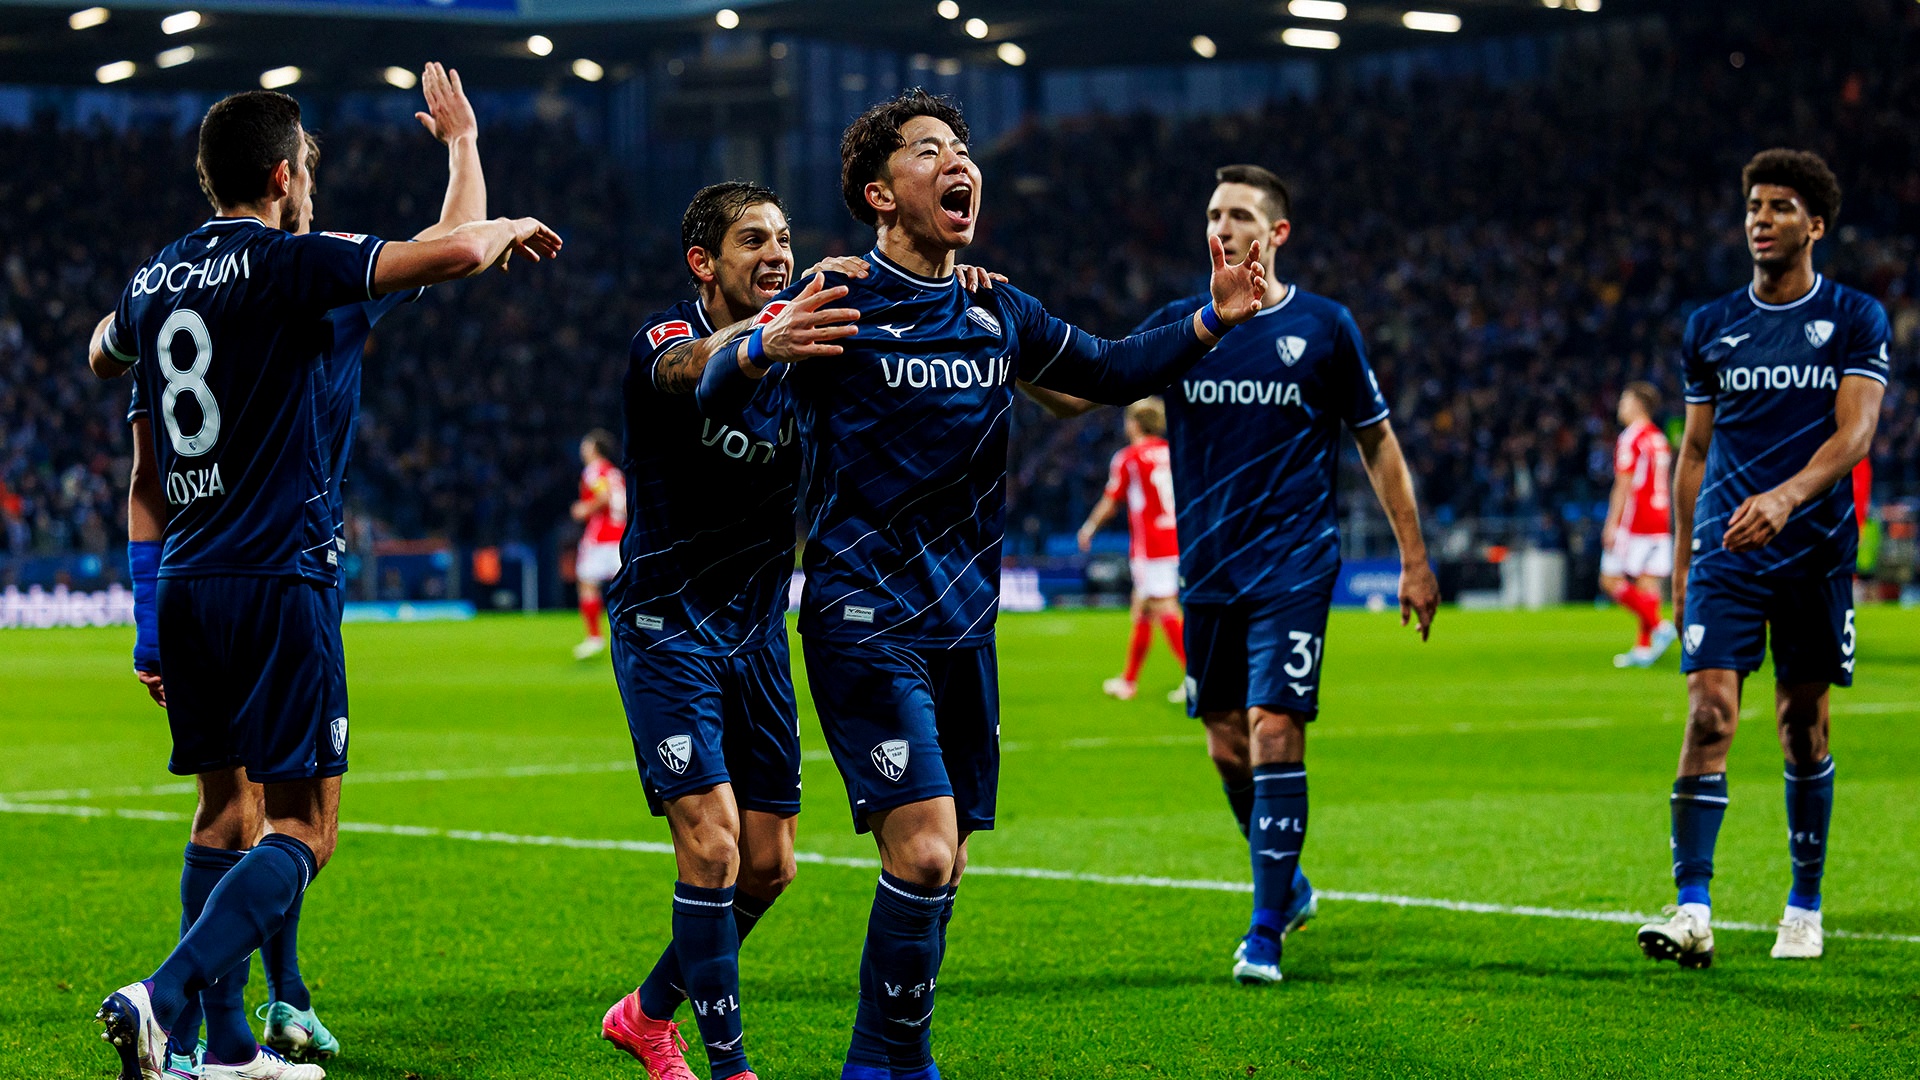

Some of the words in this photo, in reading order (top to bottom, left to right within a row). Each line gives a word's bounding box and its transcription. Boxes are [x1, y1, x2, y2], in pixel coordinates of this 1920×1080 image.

[132, 249, 250, 298] BOCHUM
[157, 308, 221, 457] 8
[1183, 380, 1301, 407] VONOVIA
[702, 417, 794, 464] VONV
[167, 463, 225, 505] LOSILA
[1283, 630, 1322, 679] 31
[1841, 609, 1856, 657] 5
